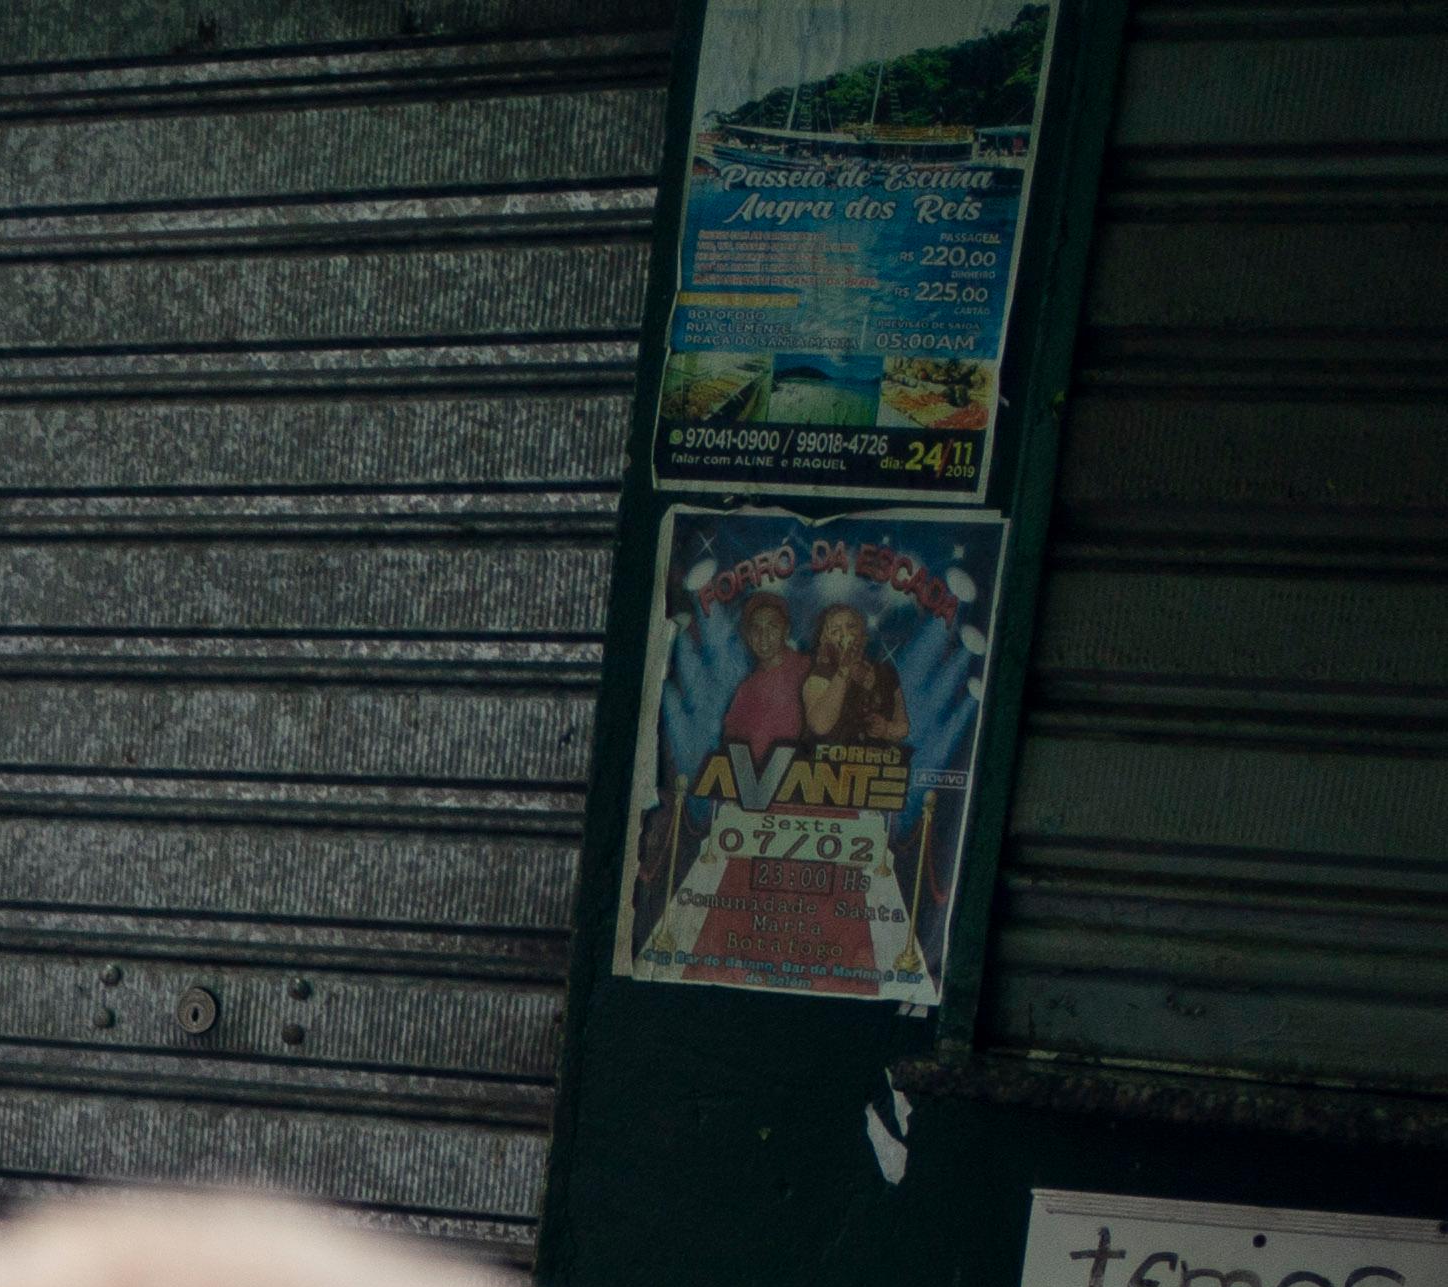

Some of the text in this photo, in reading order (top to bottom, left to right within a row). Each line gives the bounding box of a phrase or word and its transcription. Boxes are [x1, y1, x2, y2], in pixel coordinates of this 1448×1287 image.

[720, 163, 994, 191] Passeio de Escuna
[722, 192, 983, 225] Angra dos Reis
[939, 232, 1000, 244] PASSAGEM
[899, 245, 996, 268] R$ 220,00
[895, 281, 989, 304] R$ 225,00
[686, 321, 790, 335] RUA CLEMENTE
[931, 320, 946, 330] DE
[735, 335, 755, 347] DO
[876, 332, 975, 351] 05:00AM
[685, 427, 780, 452] 97041-0900
[796, 431, 888, 456] 99018-4726
[671, 451, 847, 471] falar com ALINE e RAQUEL
[880, 456, 904, 471] dia:
[945, 464, 976, 478] 2019
[811, 540, 849, 574] DA
[855, 542, 958, 625] ESCADA
[694, 743, 908, 811] AVANTE
[761, 815, 844, 834] Sexta
[719, 827, 874, 863] 07/02
[757, 863, 872, 892] 23:00 Hs
[676, 888, 906, 924] Comunidade Santa
[753, 915, 822, 936] Marta
[726, 932, 843, 958] Botafogo
[781, 960, 806, 974] Bar
